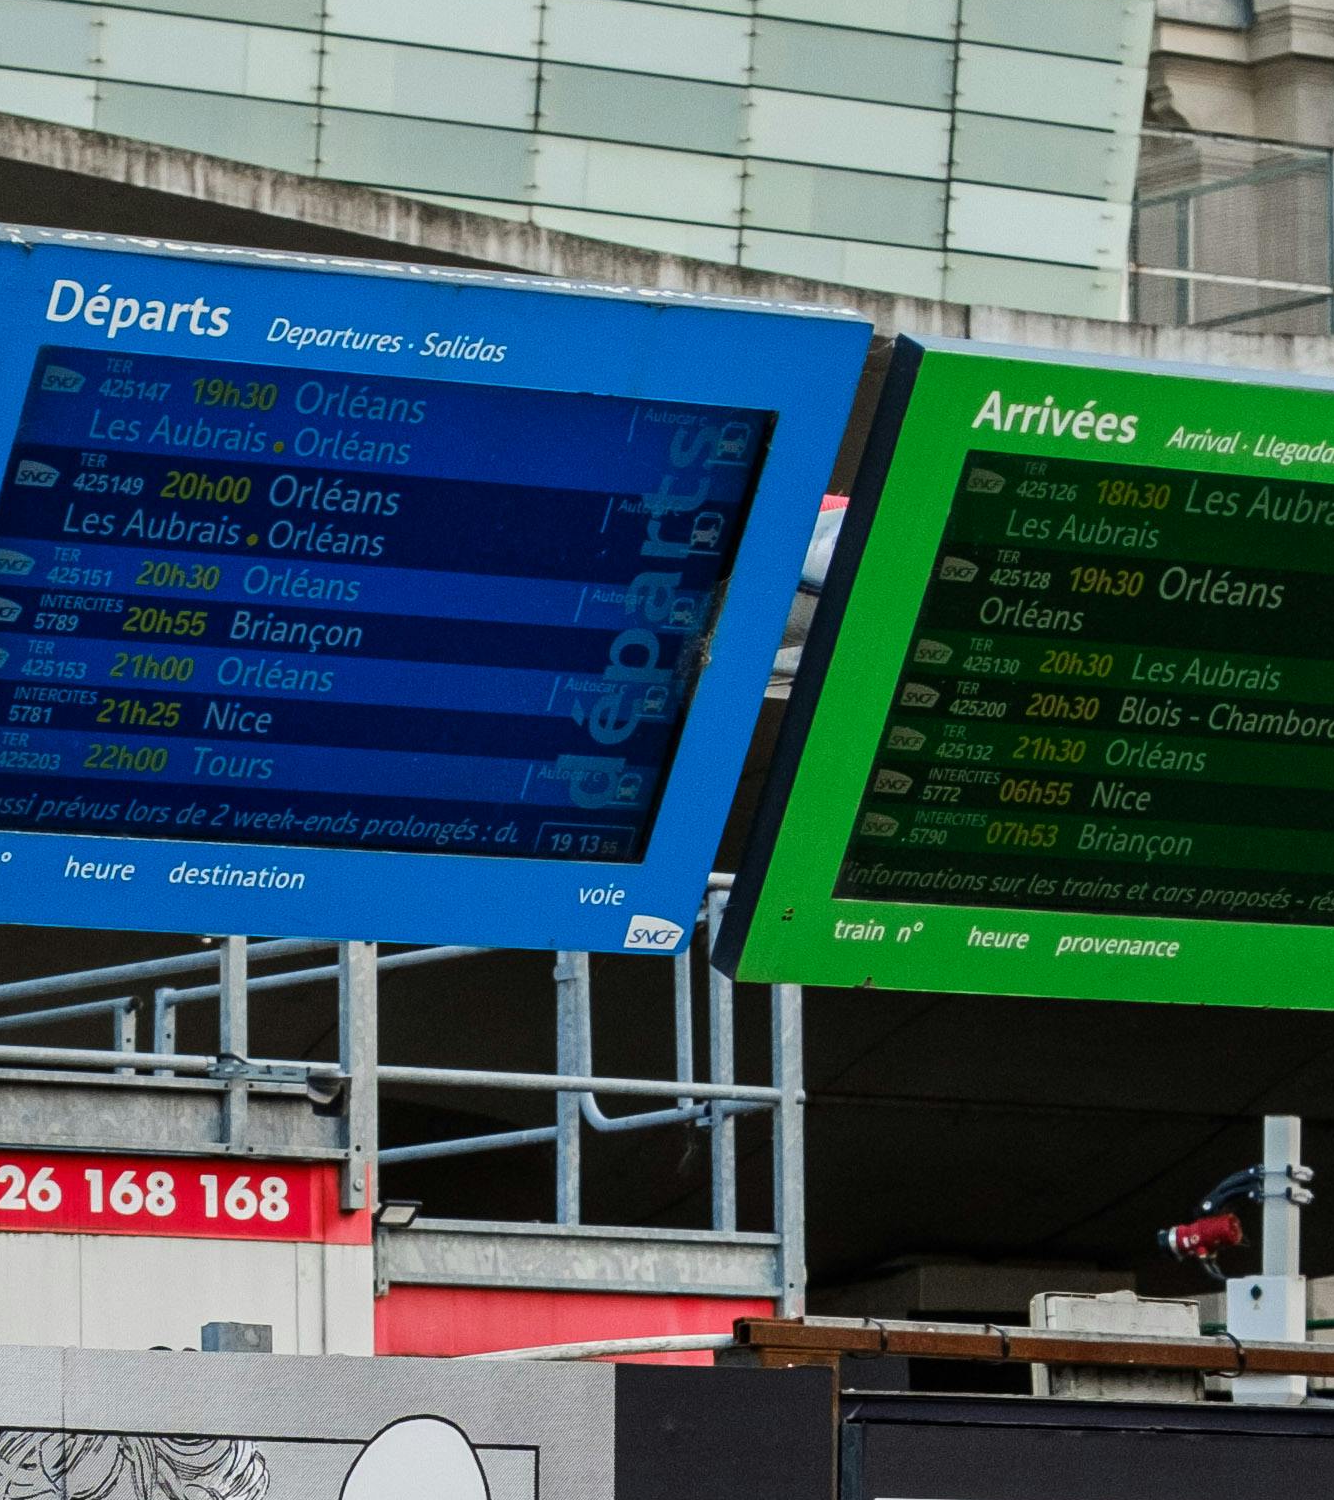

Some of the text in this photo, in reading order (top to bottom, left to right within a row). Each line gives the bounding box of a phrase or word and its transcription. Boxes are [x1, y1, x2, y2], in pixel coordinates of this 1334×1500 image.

[45, 278, 232, 339] Départs
[267, 316, 508, 363] Departures Salidas
[99, 377, 427, 424] 425147 19h30 Orléans
[971, 389, 1140, 444] Arrivées
[88, 409, 412, 466] Les Aubrais Orléans
[1166, 424, 1243, 454] Arrival
[81, 453, 108, 469] TER
[72, 470, 401, 517] 425149 20h00 Orléans
[1016, 479, 1080, 502] 425126
[1097, 478, 1172, 511] 18h30
[1184, 477, 1241, 517] Les
[63, 502, 386, 557] Les Aubrais Orléans
[1005, 508, 1160, 550] Les Aubrais
[45, 561, 362, 602] 425151 20h30 Orléans
[988, 565, 1285, 610] 425128 19h30 Orléans
[40, 593, 124, 613] INTERCITES
[556, 426, 719, 810] départs
[979, 595, 1086, 633] Orléans
[33, 606, 364, 653] 5789 20h55 Briançon
[20, 652, 335, 693] 425153 21h00 Orléans
[962, 649, 1282, 692] 425130 20h30 Les Aubrais
[8, 697, 273, 734] 5781 21h25 Nice
[14, 687, 98, 705] INTERCITES
[948, 698, 1008, 719] 425200
[1024, 691, 1101, 721] 20h30
[1117, 695, 1183, 728] Blois
[83, 743, 169, 773] 22h00
[191, 745, 275, 780] Tours
[934, 734, 1208, 773] 425132 21h30 Orléans
[921, 777, 1152, 813] 5772 06h55 Nice
[928, 767, 1003, 786] INTERCITES
[36, 795, 119, 823] prévus
[124, 799, 169, 825] lors
[175, 802, 206, 825] de
[232, 807, 360, 836] week-ends
[362, 815, 479, 846] prolongés
[915, 810, 988, 828] INTERCITES
[908, 819, 1194, 864] 5790 07h53 Briançon
[64, 854, 136, 881] heure
[168, 860, 305, 891] destination
[579, 881, 627, 906] voie
[1027, 873, 1291, 914] les trains cars proposés
[629, 927, 680, 945] SNCF
[833, 917, 924, 944] train n°
[967, 924, 1030, 950] heure
[1055, 933, 1181, 959] provenance
[84, 1168, 177, 1217] 168
[199, 1173, 290, 1222] 168
